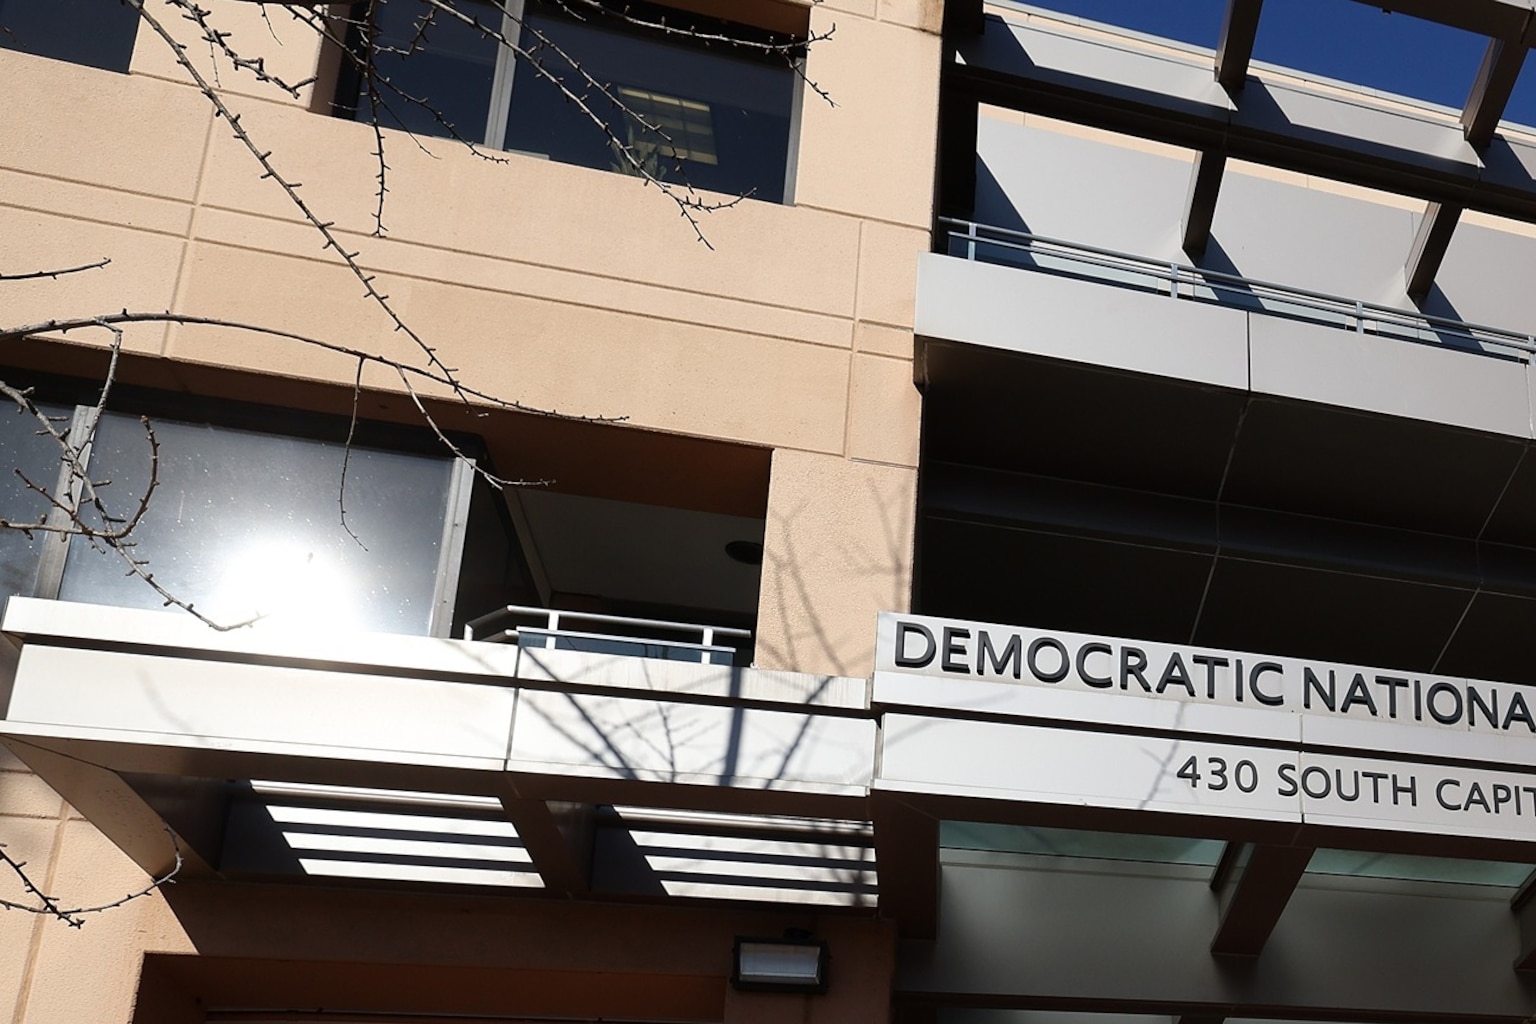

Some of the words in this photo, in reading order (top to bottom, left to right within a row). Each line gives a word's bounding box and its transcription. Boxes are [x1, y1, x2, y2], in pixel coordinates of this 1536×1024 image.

[894, 621, 1285, 706] DEMOCRATIC
[1176, 756, 1259, 793] 430
[1278, 763, 1417, 807] SOUTH
